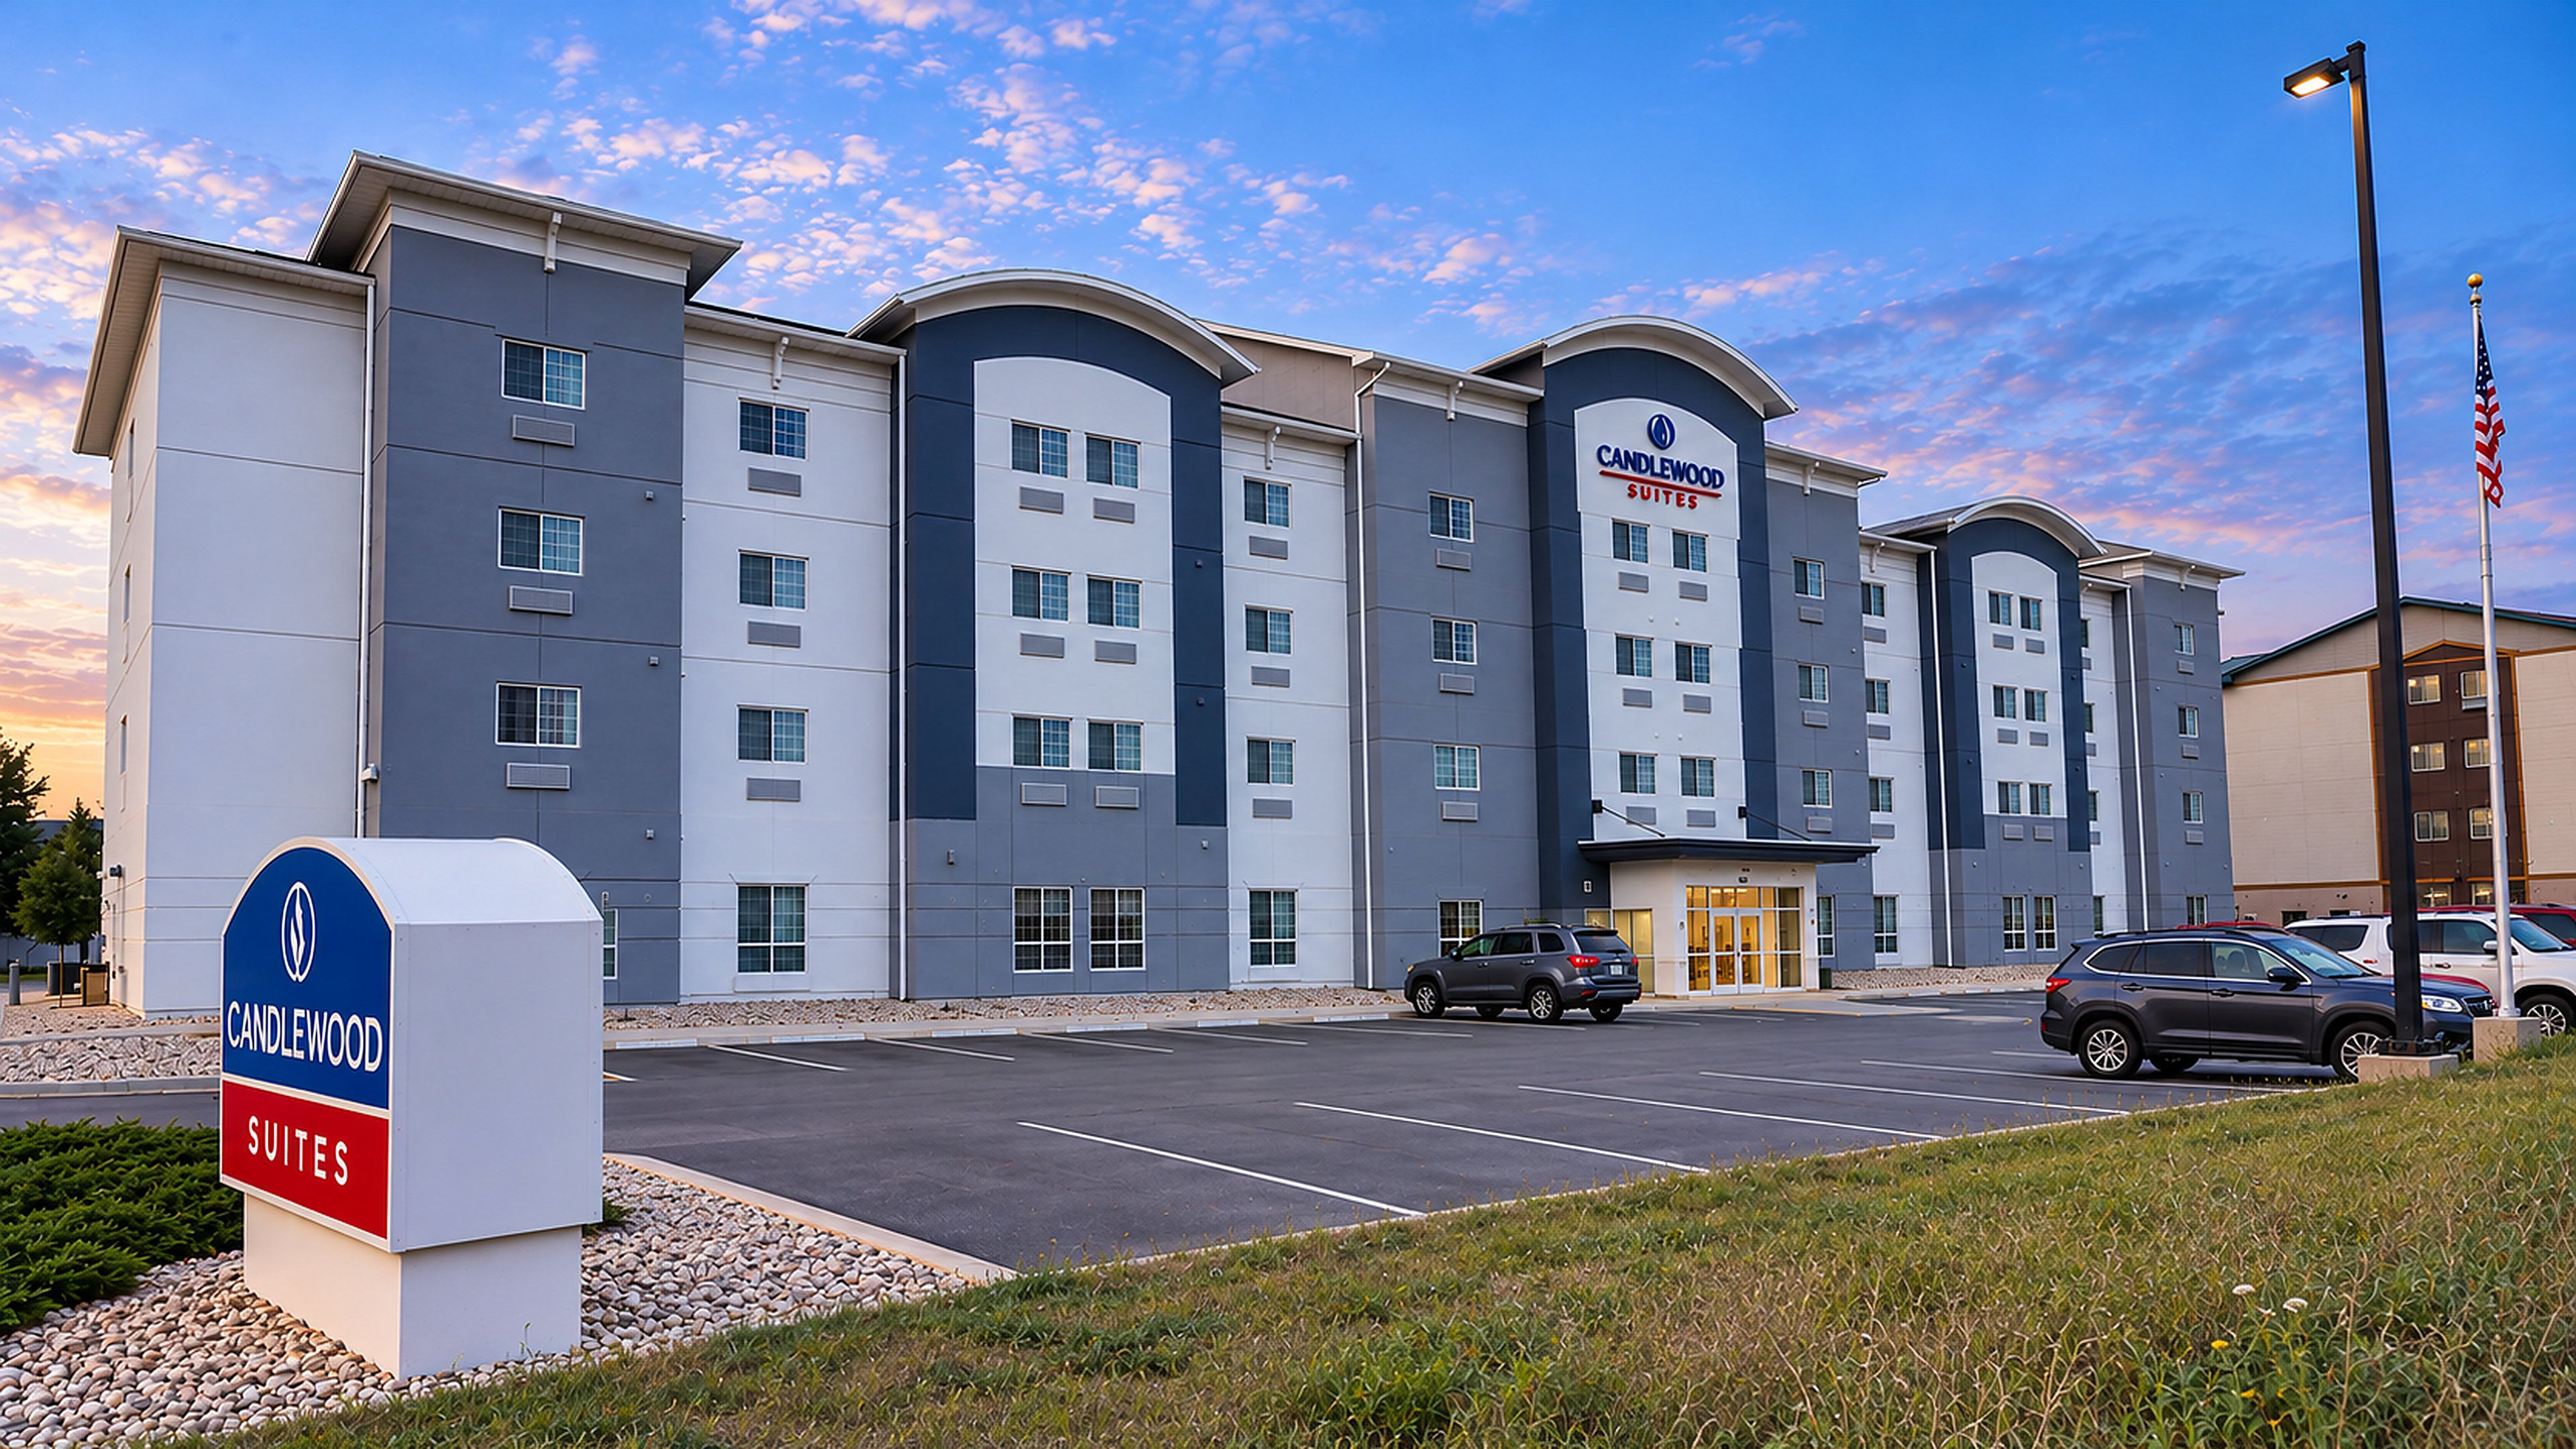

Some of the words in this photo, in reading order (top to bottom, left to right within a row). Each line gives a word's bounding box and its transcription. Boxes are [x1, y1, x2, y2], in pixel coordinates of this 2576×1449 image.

[1597, 445, 1725, 489] CANDLEWOOD
[1627, 484, 1698, 509] SUITES
[227, 1001, 383, 1072] CANDLEWOOD
[248, 1116, 348, 1185] SUITES
